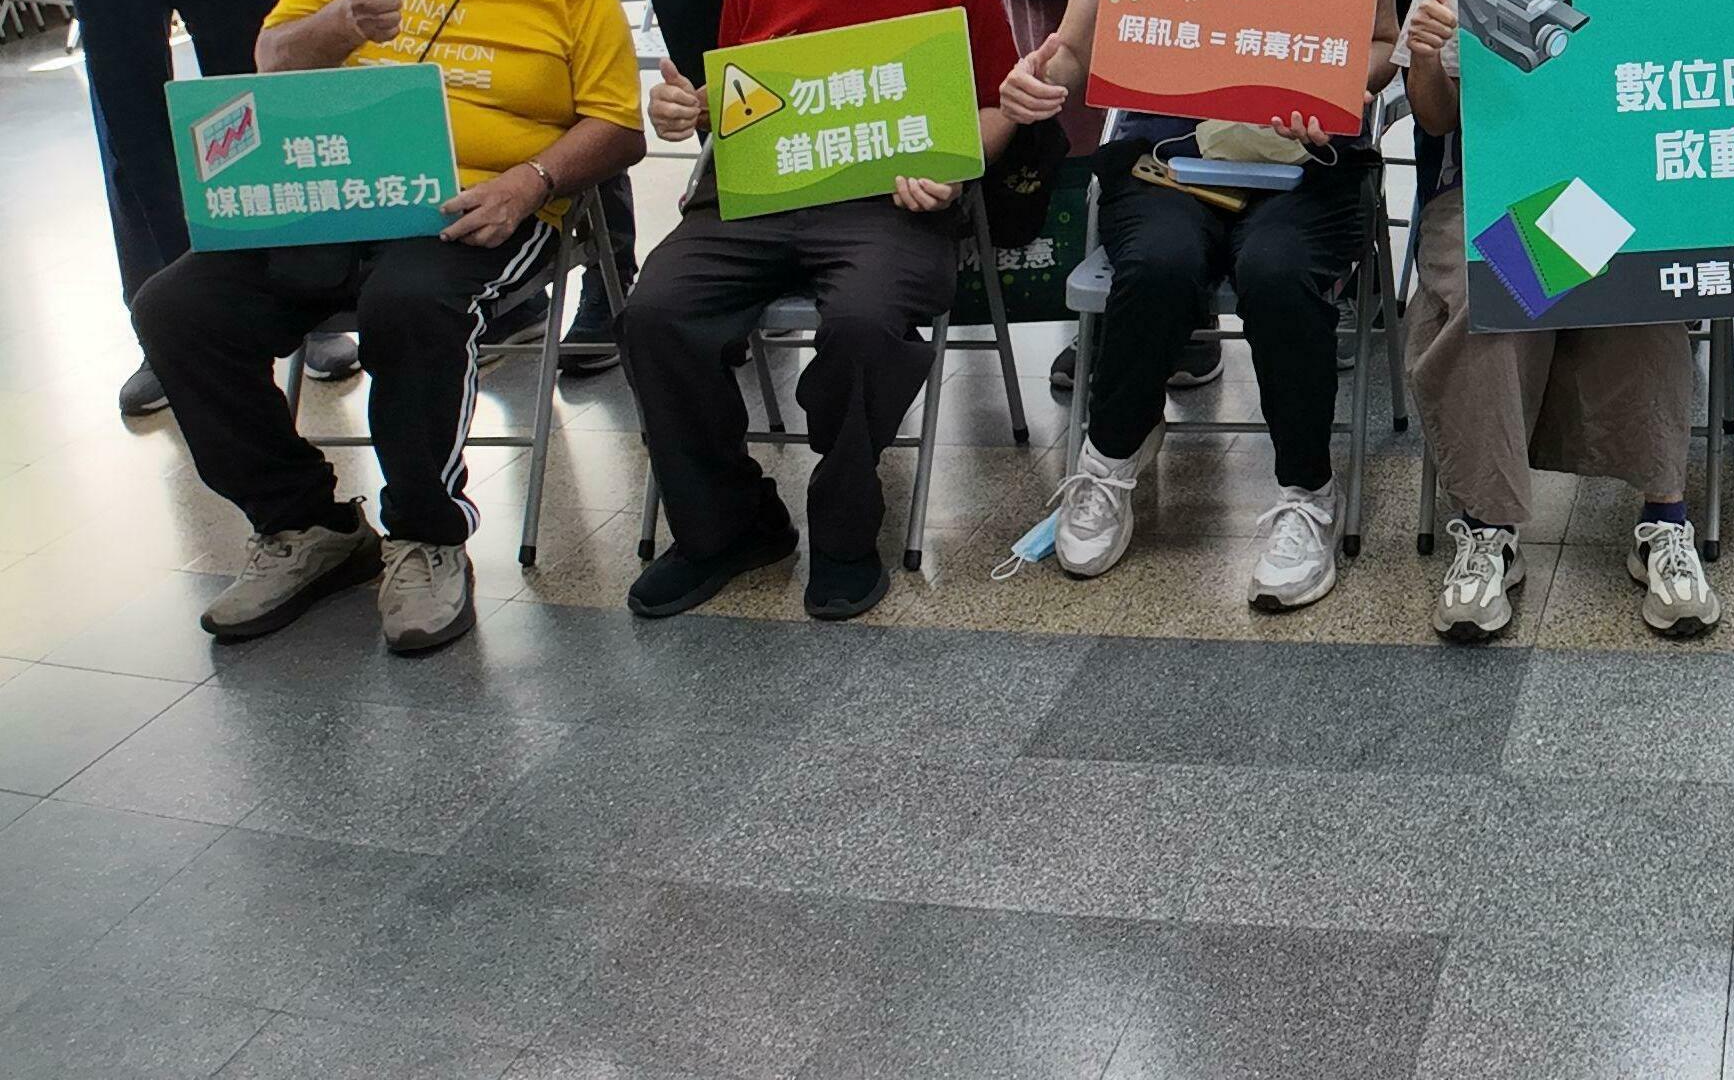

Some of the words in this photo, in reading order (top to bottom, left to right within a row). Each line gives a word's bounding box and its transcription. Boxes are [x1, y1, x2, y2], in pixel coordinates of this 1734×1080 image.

[1117, 13, 1200, 50] 假訊息
[1210, 31, 1227, 46] =
[1234, 27, 1349, 68] 病毒行銷
[788, 61, 908, 117] 勿轉傳
[282, 133, 352, 171] 增強
[774, 114, 934, 177] 錯假訊息
[204, 173, 443, 219] 媒體識讀免疫力
